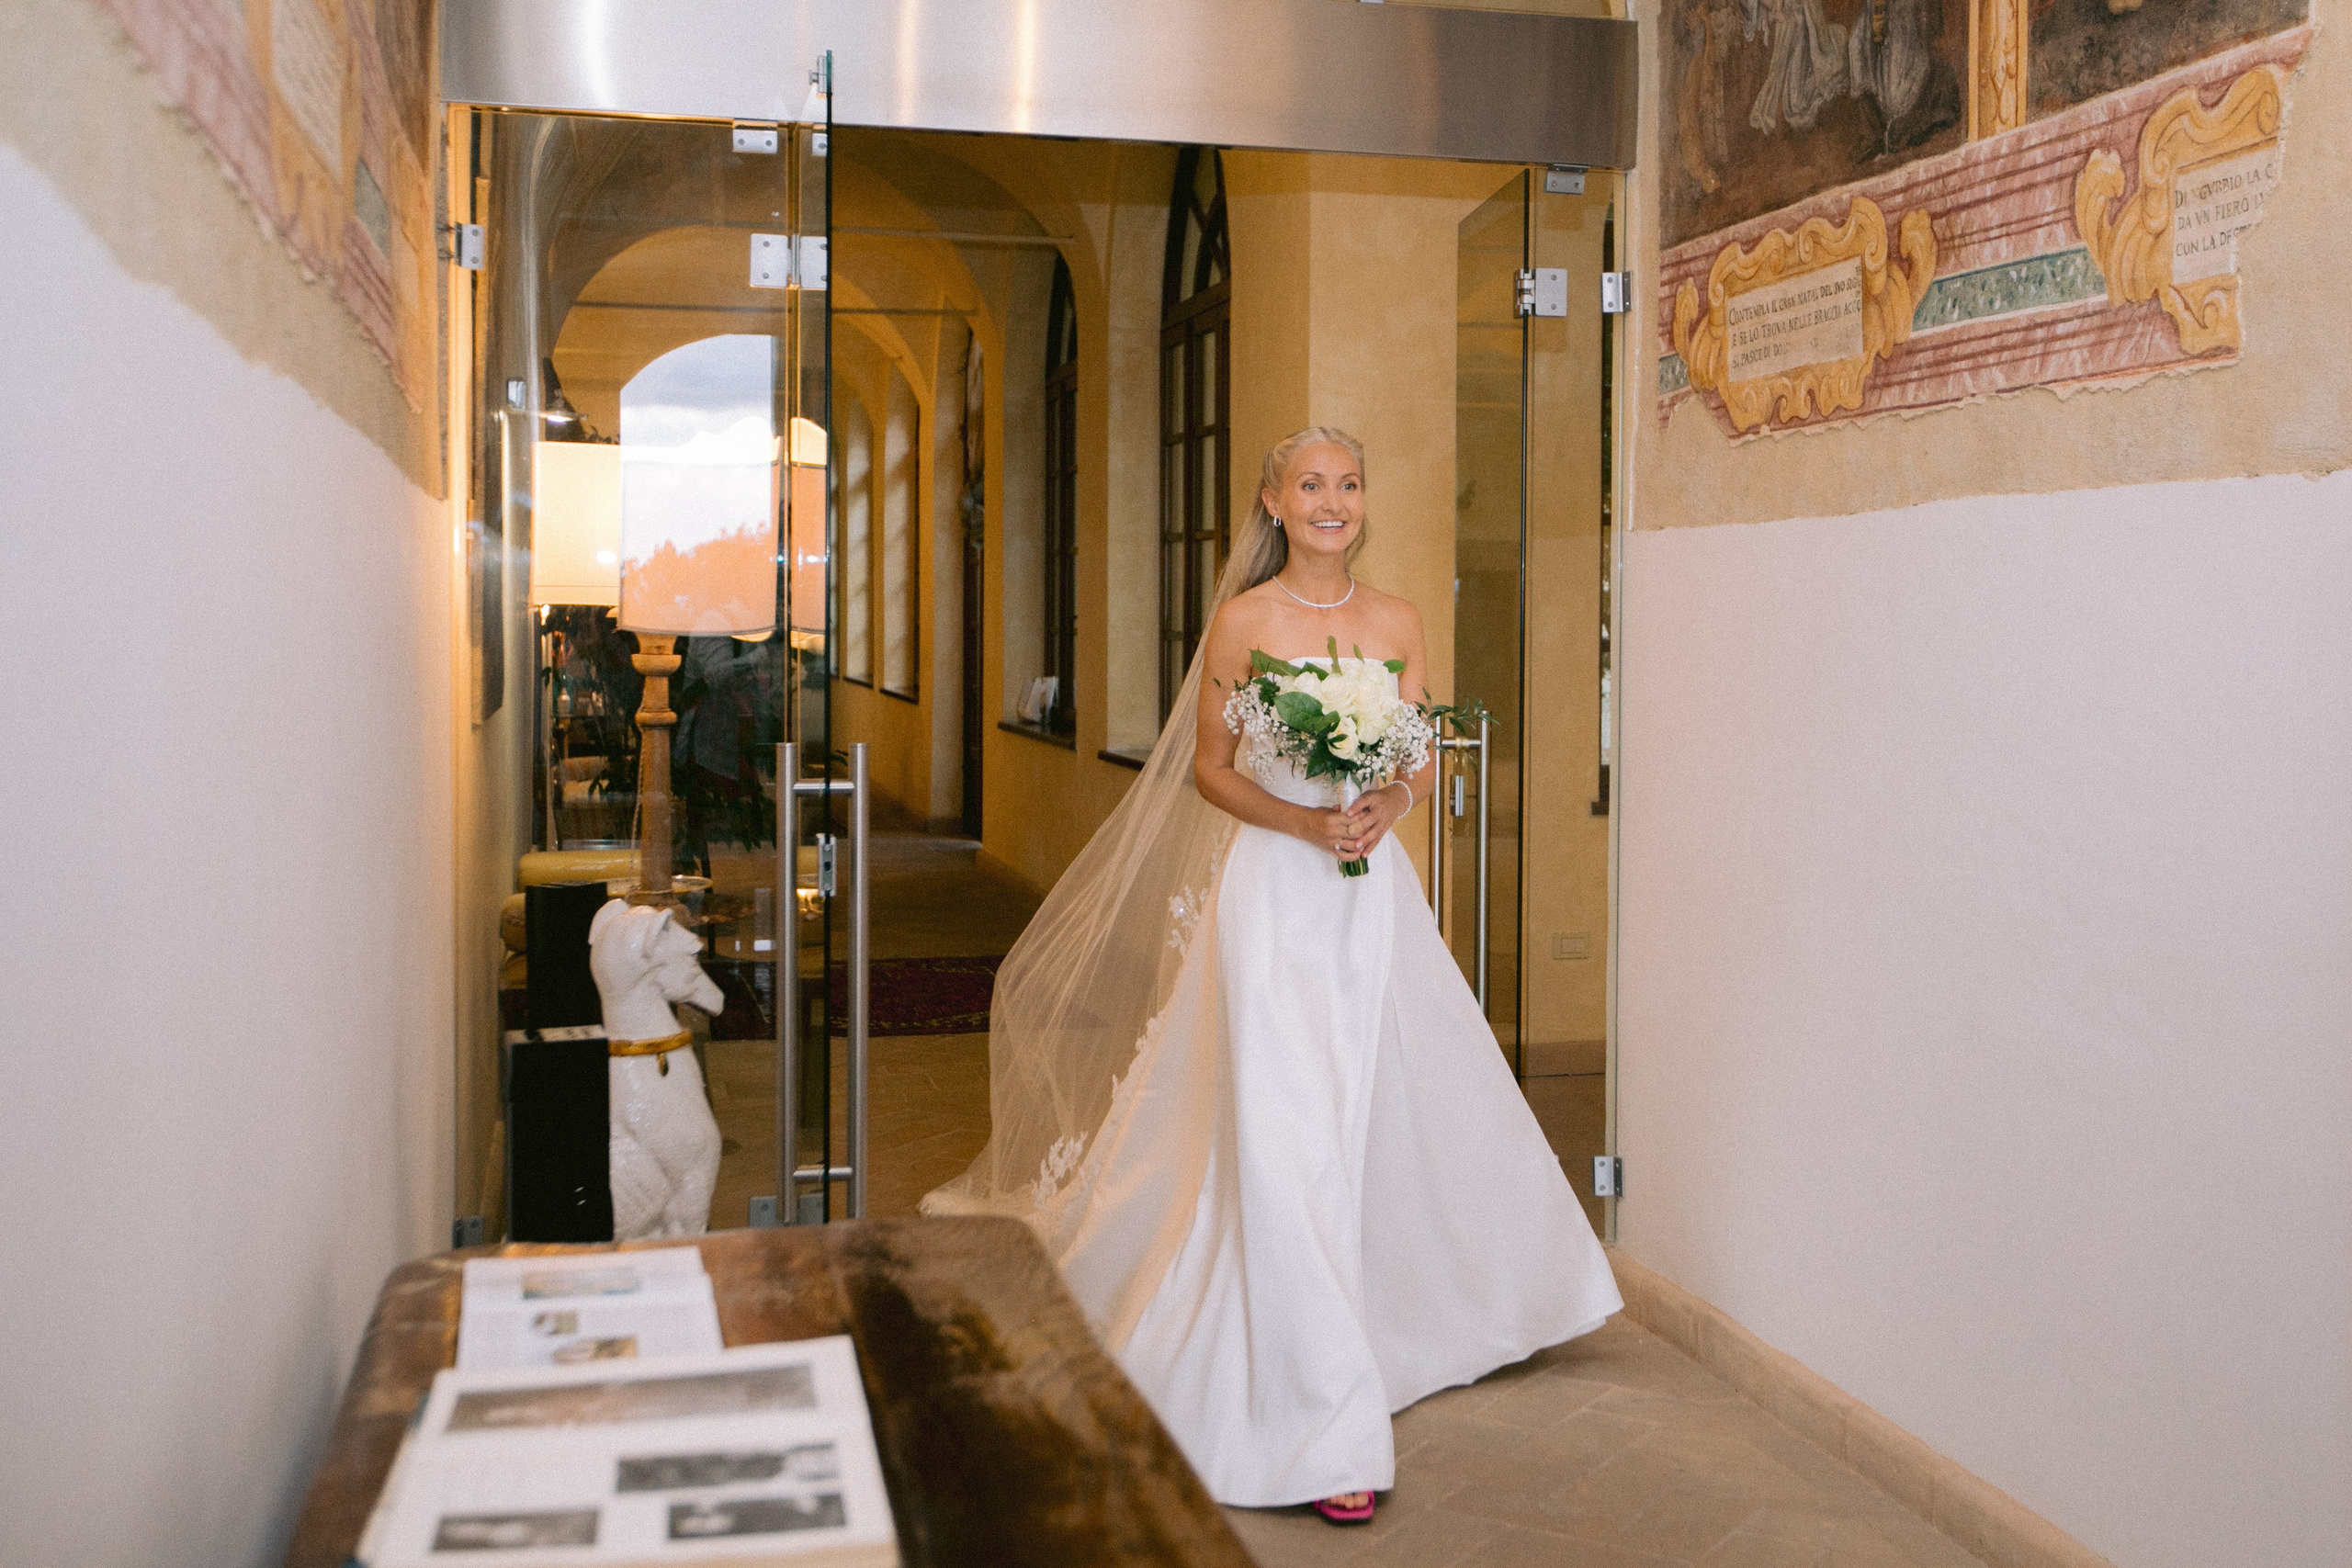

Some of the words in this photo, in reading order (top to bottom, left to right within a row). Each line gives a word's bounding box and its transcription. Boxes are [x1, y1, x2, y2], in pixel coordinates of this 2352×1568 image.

[2246, 169, 2261, 185] LA
[2214, 197, 2249, 221] FIERO
[2175, 238, 2199, 257] CON
[2202, 235, 2216, 252] LA
[1820, 284, 1833, 299] DEL
[1749, 327, 1758, 343] LO
[1761, 321, 1787, 339] TROVA
[1788, 313, 1812, 333] NELLE
